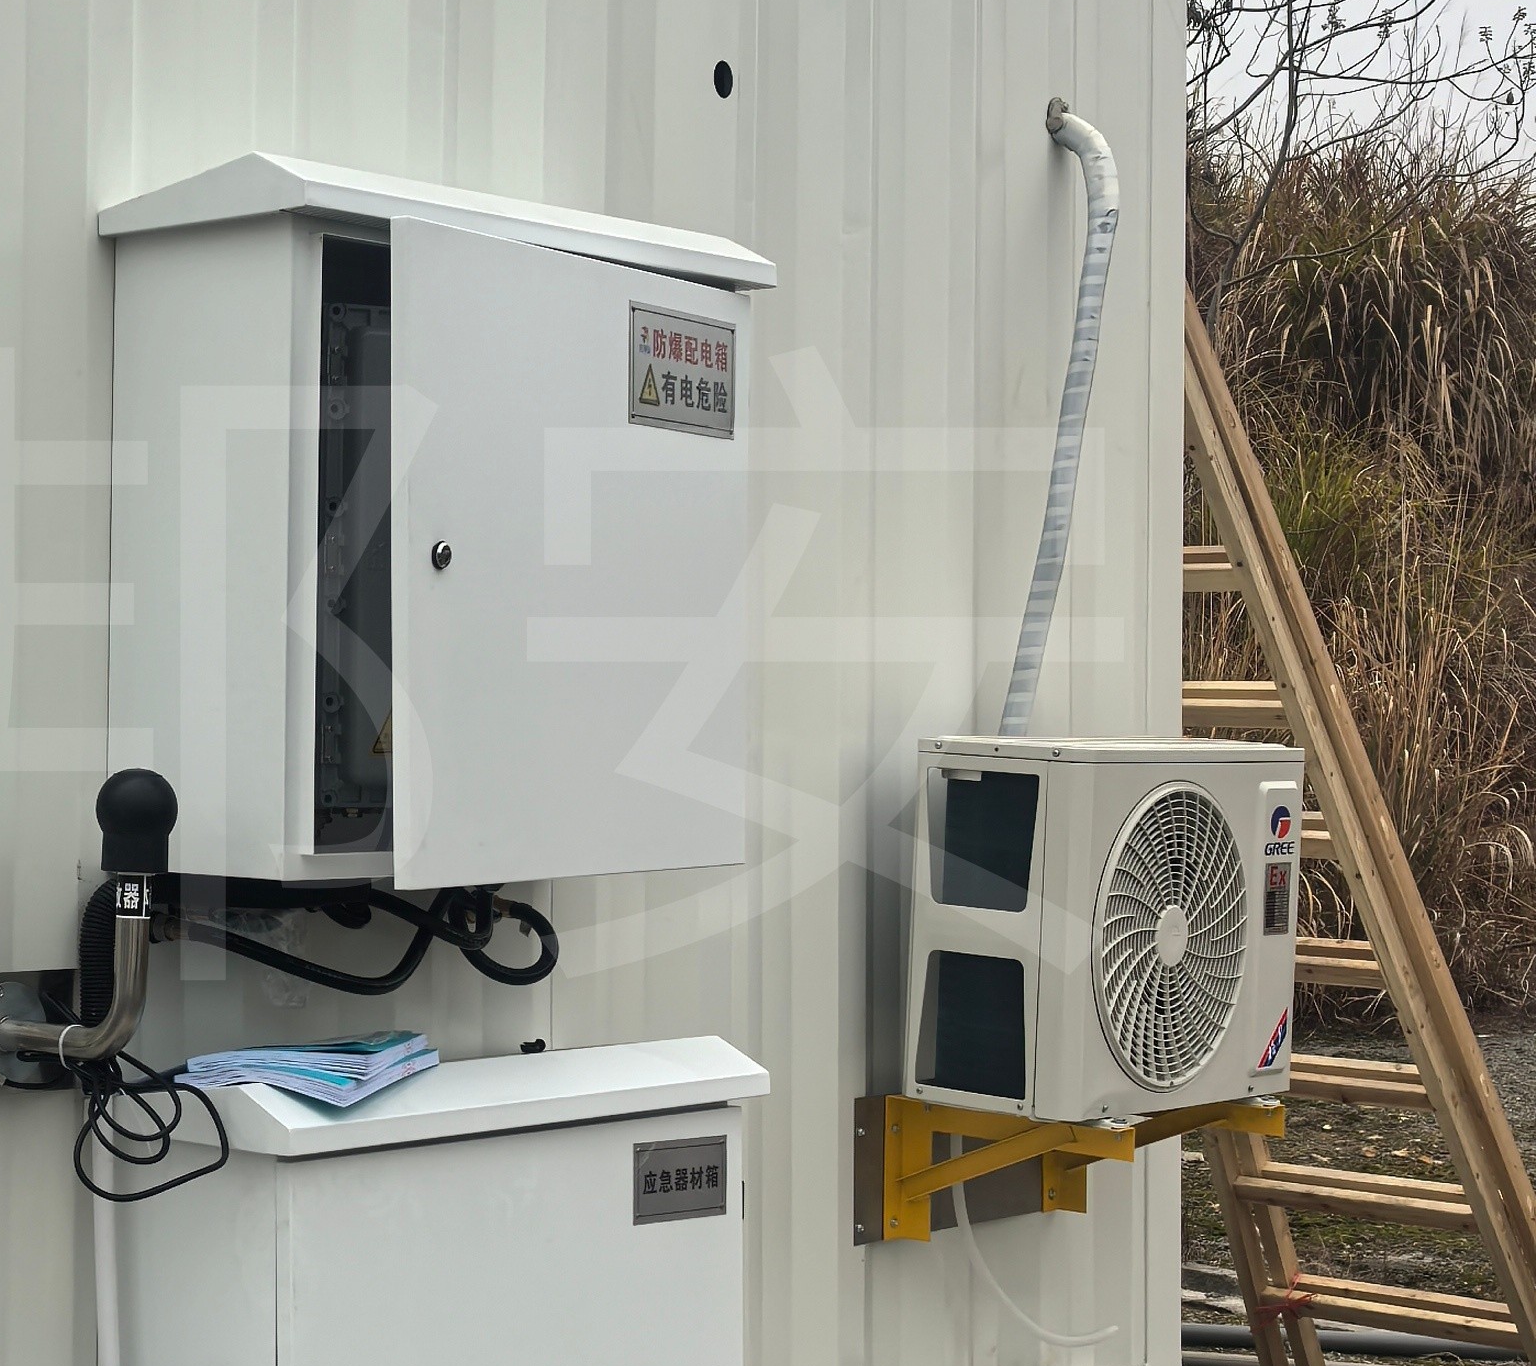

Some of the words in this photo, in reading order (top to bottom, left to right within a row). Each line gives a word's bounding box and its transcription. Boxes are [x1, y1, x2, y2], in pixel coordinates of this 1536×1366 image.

[652, 327, 729, 373] 防爆配电箱
[661, 371, 728, 414] 有电危险
[1265, 840, 1295, 857] GREE
[1269, 865, 1287, 887] Ex
[642, 1164, 720, 1195] 应急器材箱
